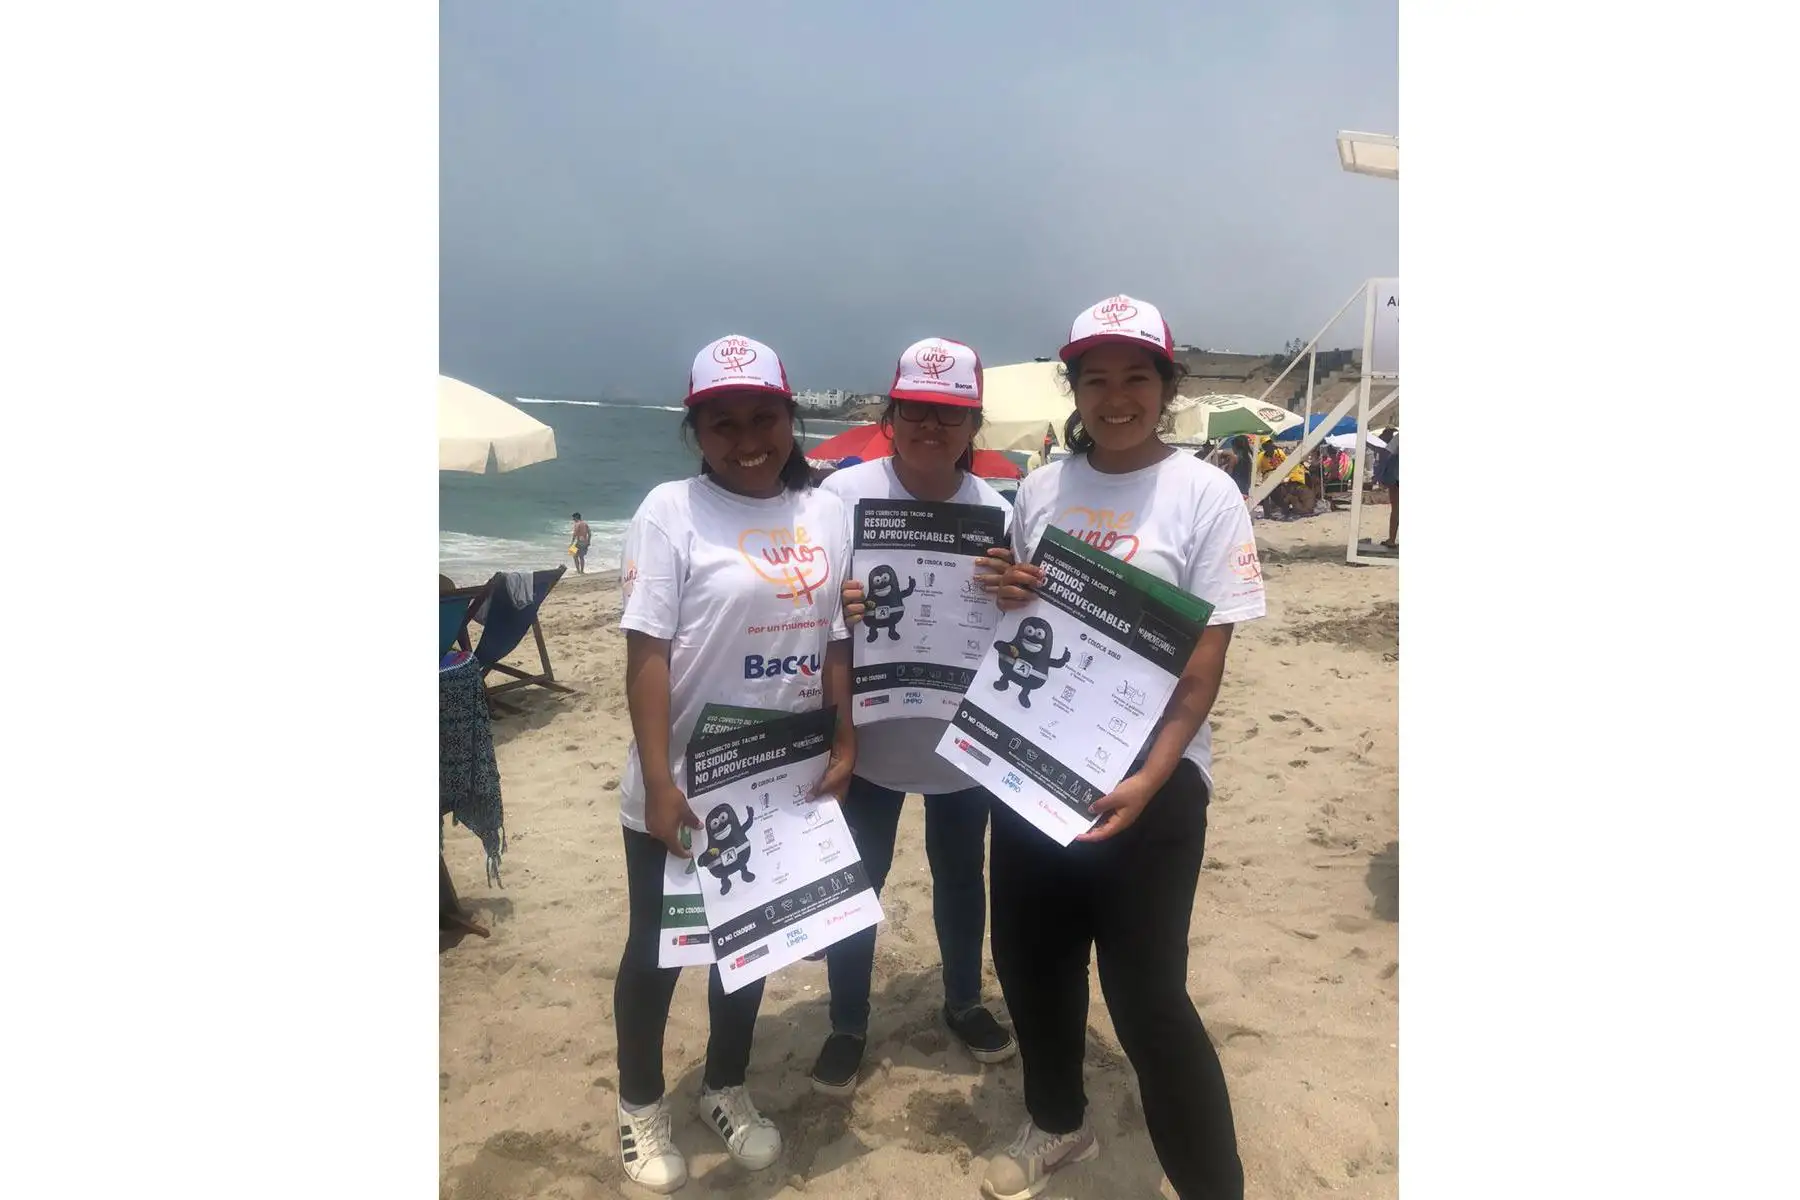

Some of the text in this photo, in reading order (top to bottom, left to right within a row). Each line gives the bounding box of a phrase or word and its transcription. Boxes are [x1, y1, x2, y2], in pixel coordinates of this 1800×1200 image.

[1102, 303, 1128, 313] uno
[1387, 296, 1399, 306] A
[728, 339, 748, 347] me
[721, 347, 747, 356] uno
[923, 353, 946, 363] uno
[864, 518, 906, 528] RESIDUOS
[1089, 509, 1136, 530] me
[769, 526, 811, 545] me
[863, 530, 955, 544] NO APROVECHABLES
[762, 545, 814, 566] uno
[1040, 560, 1086, 592] RESIDUOS
[1054, 557, 1081, 577] CORRECTO
[1080, 573, 1090, 582] DEL
[1091, 579, 1108, 592] TACHO
[1108, 588, 1117, 597] DE
[1048, 582, 1131, 634] APROVECHABLES
[748, 626, 766, 635] Por
[782, 620, 816, 631] mundo
[1087, 638, 1106, 653] COLOCA
[744, 652, 820, 680] Backu
[968, 716, 976, 724] NO
[706, 743, 730, 756] CORRECTO
[741, 735, 758, 744] TACHO
[758, 732, 766, 740] DE
[694, 748, 738, 773] RESIDUOS
[695, 771, 710, 786] NO
[712, 747, 787, 778] APROVECHABLES
[724, 933, 733, 942] NO
